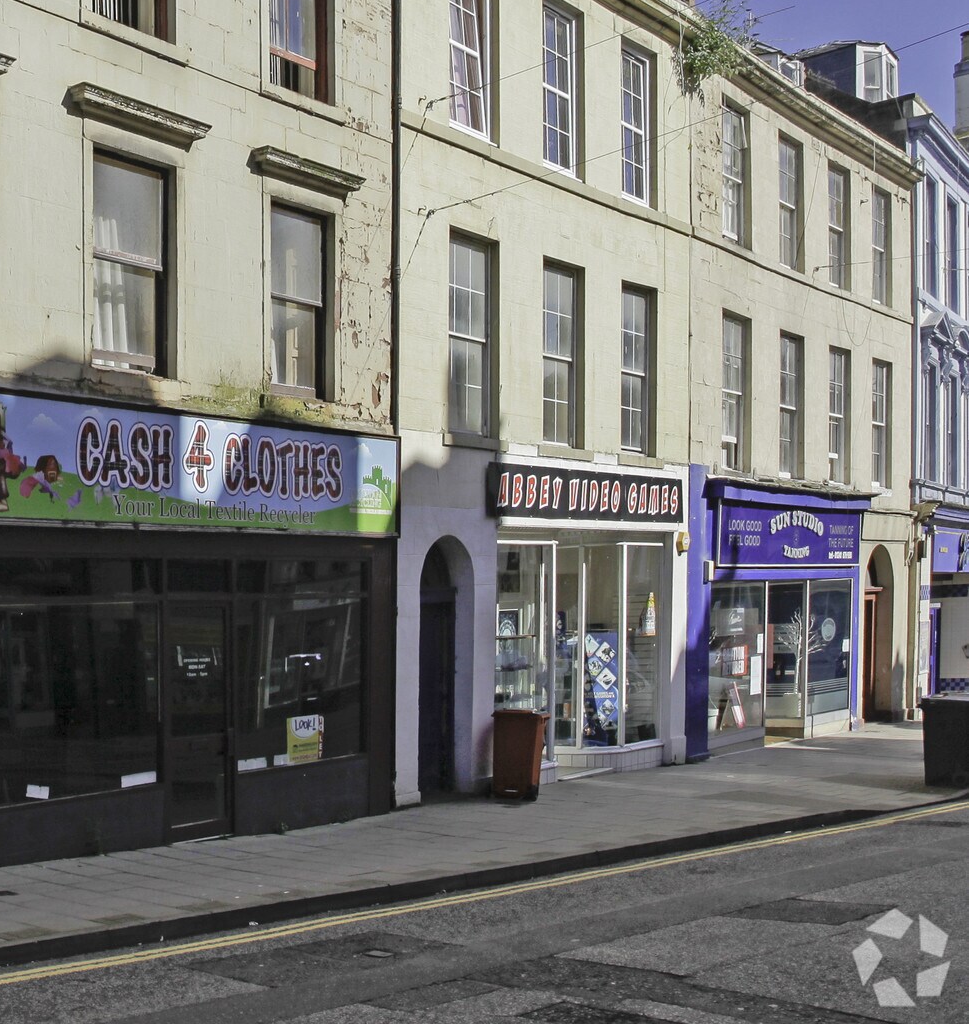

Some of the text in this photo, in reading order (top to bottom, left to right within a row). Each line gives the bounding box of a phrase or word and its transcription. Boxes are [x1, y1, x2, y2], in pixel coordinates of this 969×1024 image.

[76, 416, 344, 503] CASH 4 CLOTHES
[497, 472, 679, 515] ABBEY VIDEO GAMES
[113, 494, 316, 527] Your Local Textile Recycler
[728, 519, 762, 532] LOOK GOOD
[770, 511, 824, 536] SUN STUDIO
[744, 535, 761, 546] GOOD
[783, 545, 810, 559] TANNING
[294, 717, 317, 732] Look!
